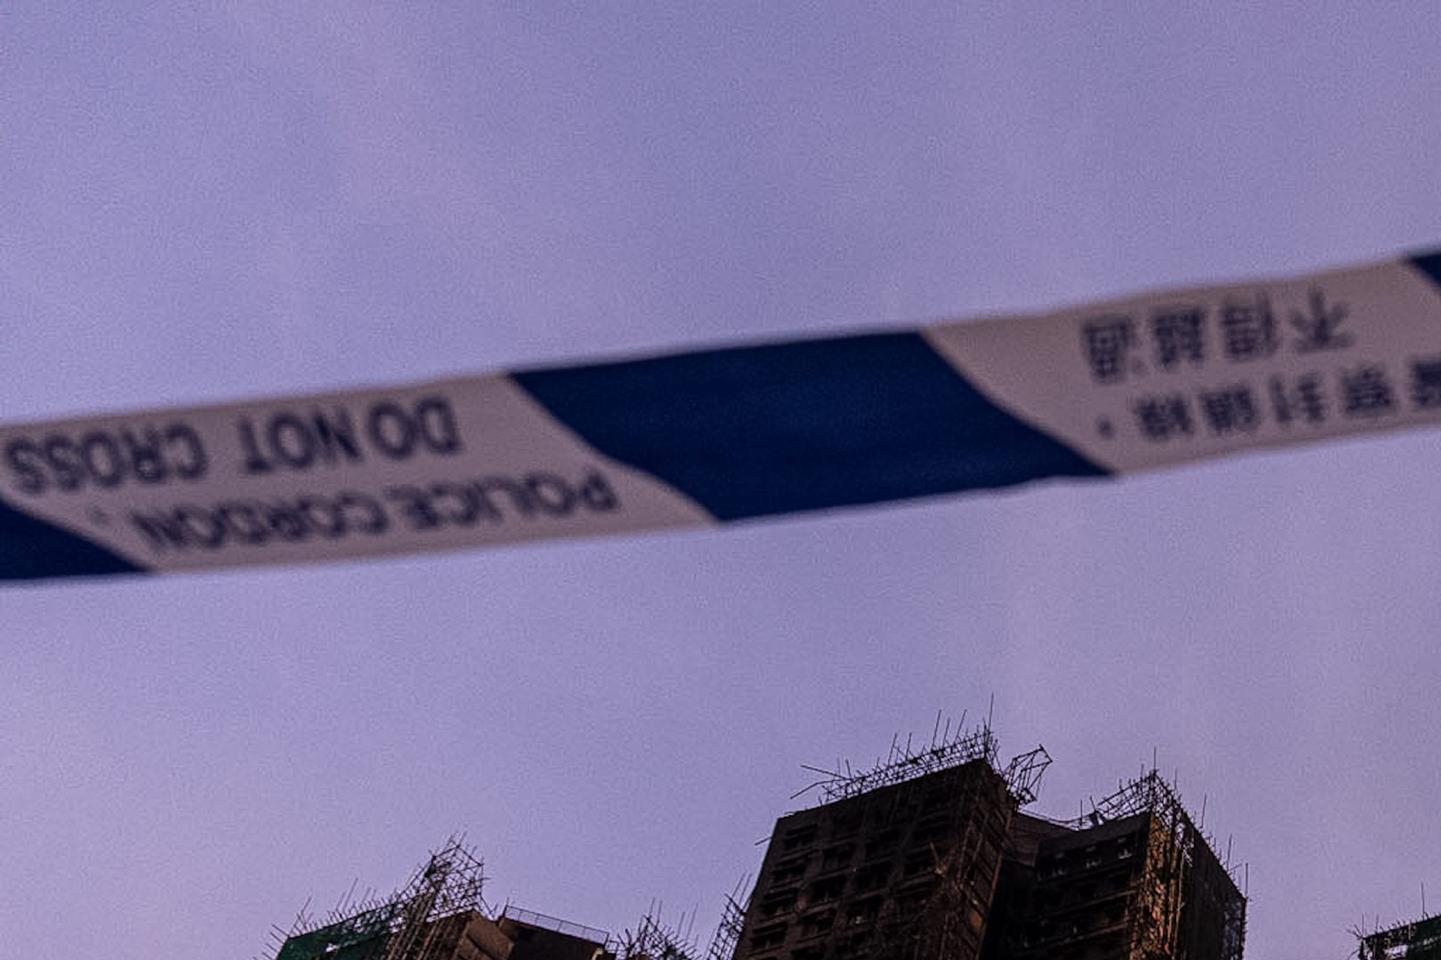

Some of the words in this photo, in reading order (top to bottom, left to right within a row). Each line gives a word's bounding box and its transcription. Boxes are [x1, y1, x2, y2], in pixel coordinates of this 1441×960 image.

[4, 423, 208, 494] CROSS
[238, 404, 360, 475] NOT
[366, 397, 462, 460] DO
[388, 467, 618, 531] POLICE
